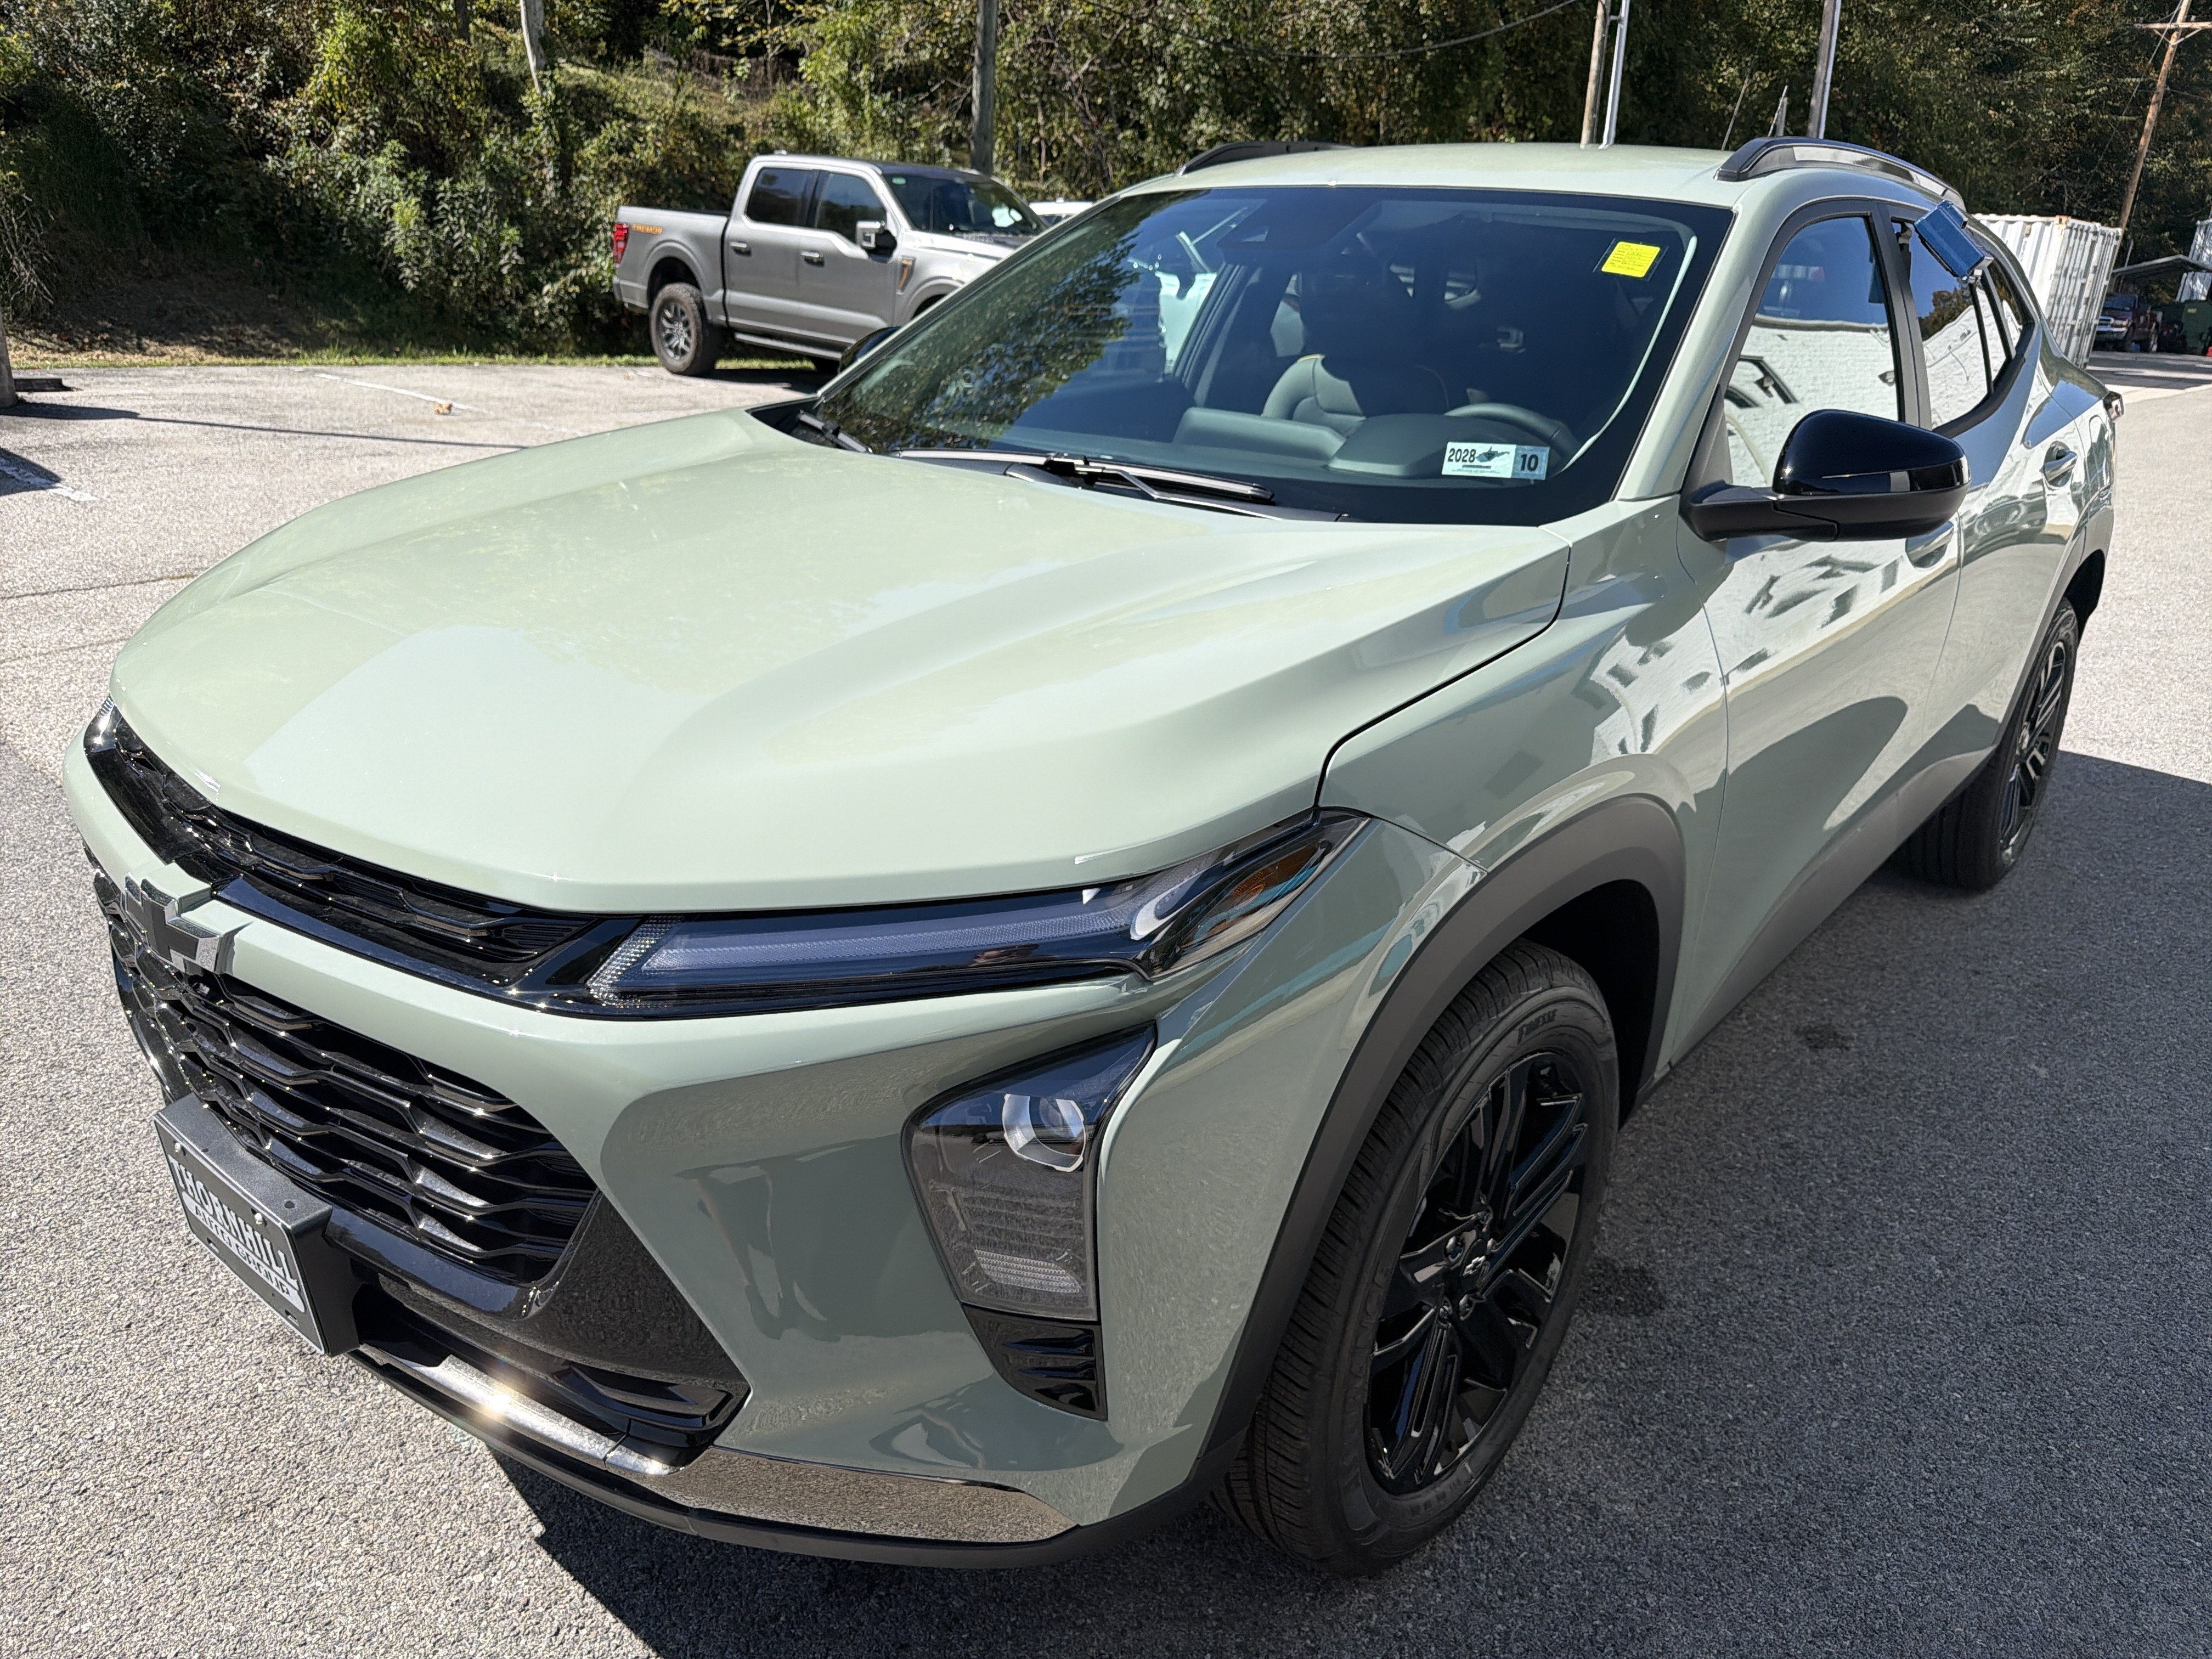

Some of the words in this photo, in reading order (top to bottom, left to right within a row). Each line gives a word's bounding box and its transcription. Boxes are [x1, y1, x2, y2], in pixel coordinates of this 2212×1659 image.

[1448, 448, 1476, 463] 2028
[1520, 454, 1538, 472] 10
[167, 1154, 299, 1291] THORNHILL
[194, 1205, 232, 1248] AUTO
[235, 1243, 290, 1296] GROUP
